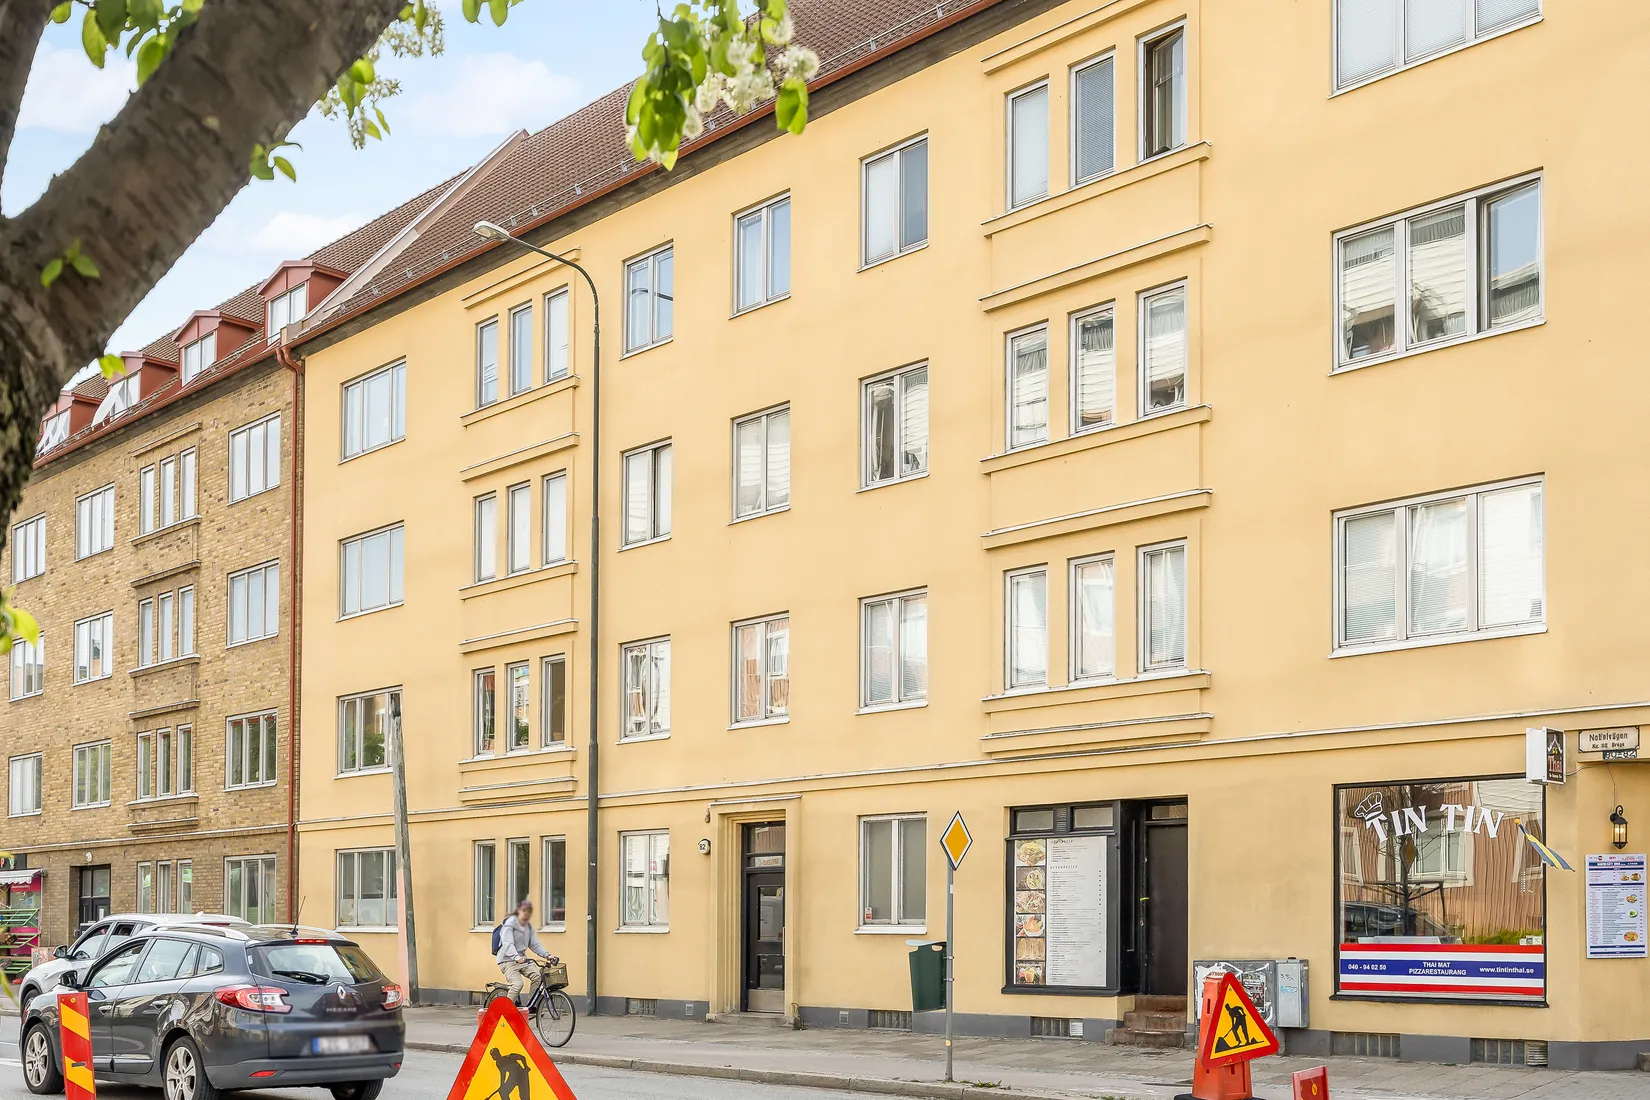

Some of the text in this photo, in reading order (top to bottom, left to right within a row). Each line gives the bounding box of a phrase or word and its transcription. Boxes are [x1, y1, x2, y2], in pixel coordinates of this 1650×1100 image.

[1589, 732, 1628, 741] Nobelvägen
[1365, 804, 1505, 843] TIN TIN
[1408, 968, 1467, 976] PIZZARESTAURANG
[1479, 966, 1534, 974] www.tintinthai.se
